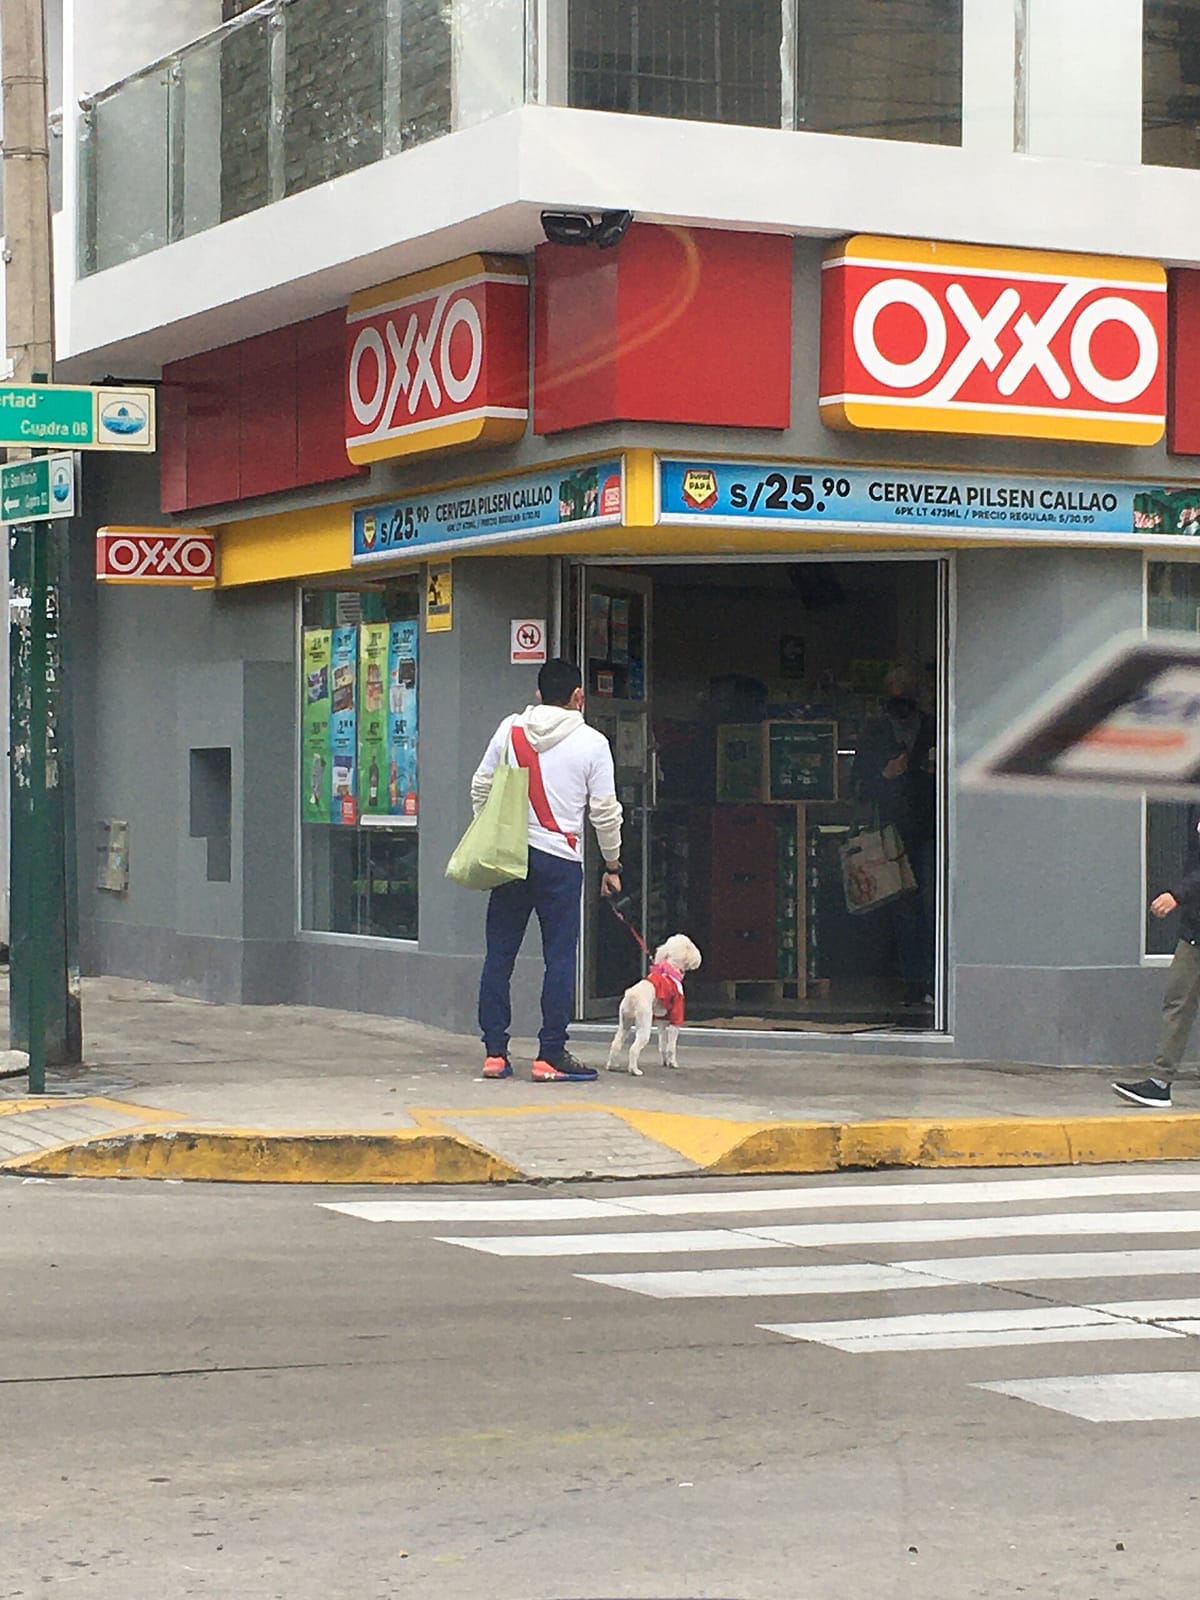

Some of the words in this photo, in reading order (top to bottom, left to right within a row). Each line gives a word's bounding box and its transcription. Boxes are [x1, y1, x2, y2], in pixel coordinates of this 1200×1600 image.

[852, 278, 1159, 404] OXXO
[349, 293, 483, 430] OXXO
[0, 392, 37, 408] rtad
[21, 419, 69, 436] Cuadra
[72, 421, 89, 436] 08
[436, 499, 477, 522] CERVEZA
[479, 492, 511, 515] PILSEN
[513, 485, 552, 509] CALLAO
[868, 482, 962, 505] CERVEZA
[966, 487, 1035, 508] PILSEN
[1039, 491, 1118, 512] CALLAO
[972, 510, 1007, 520] PRECIO
[108, 537, 212, 575] OXXO
